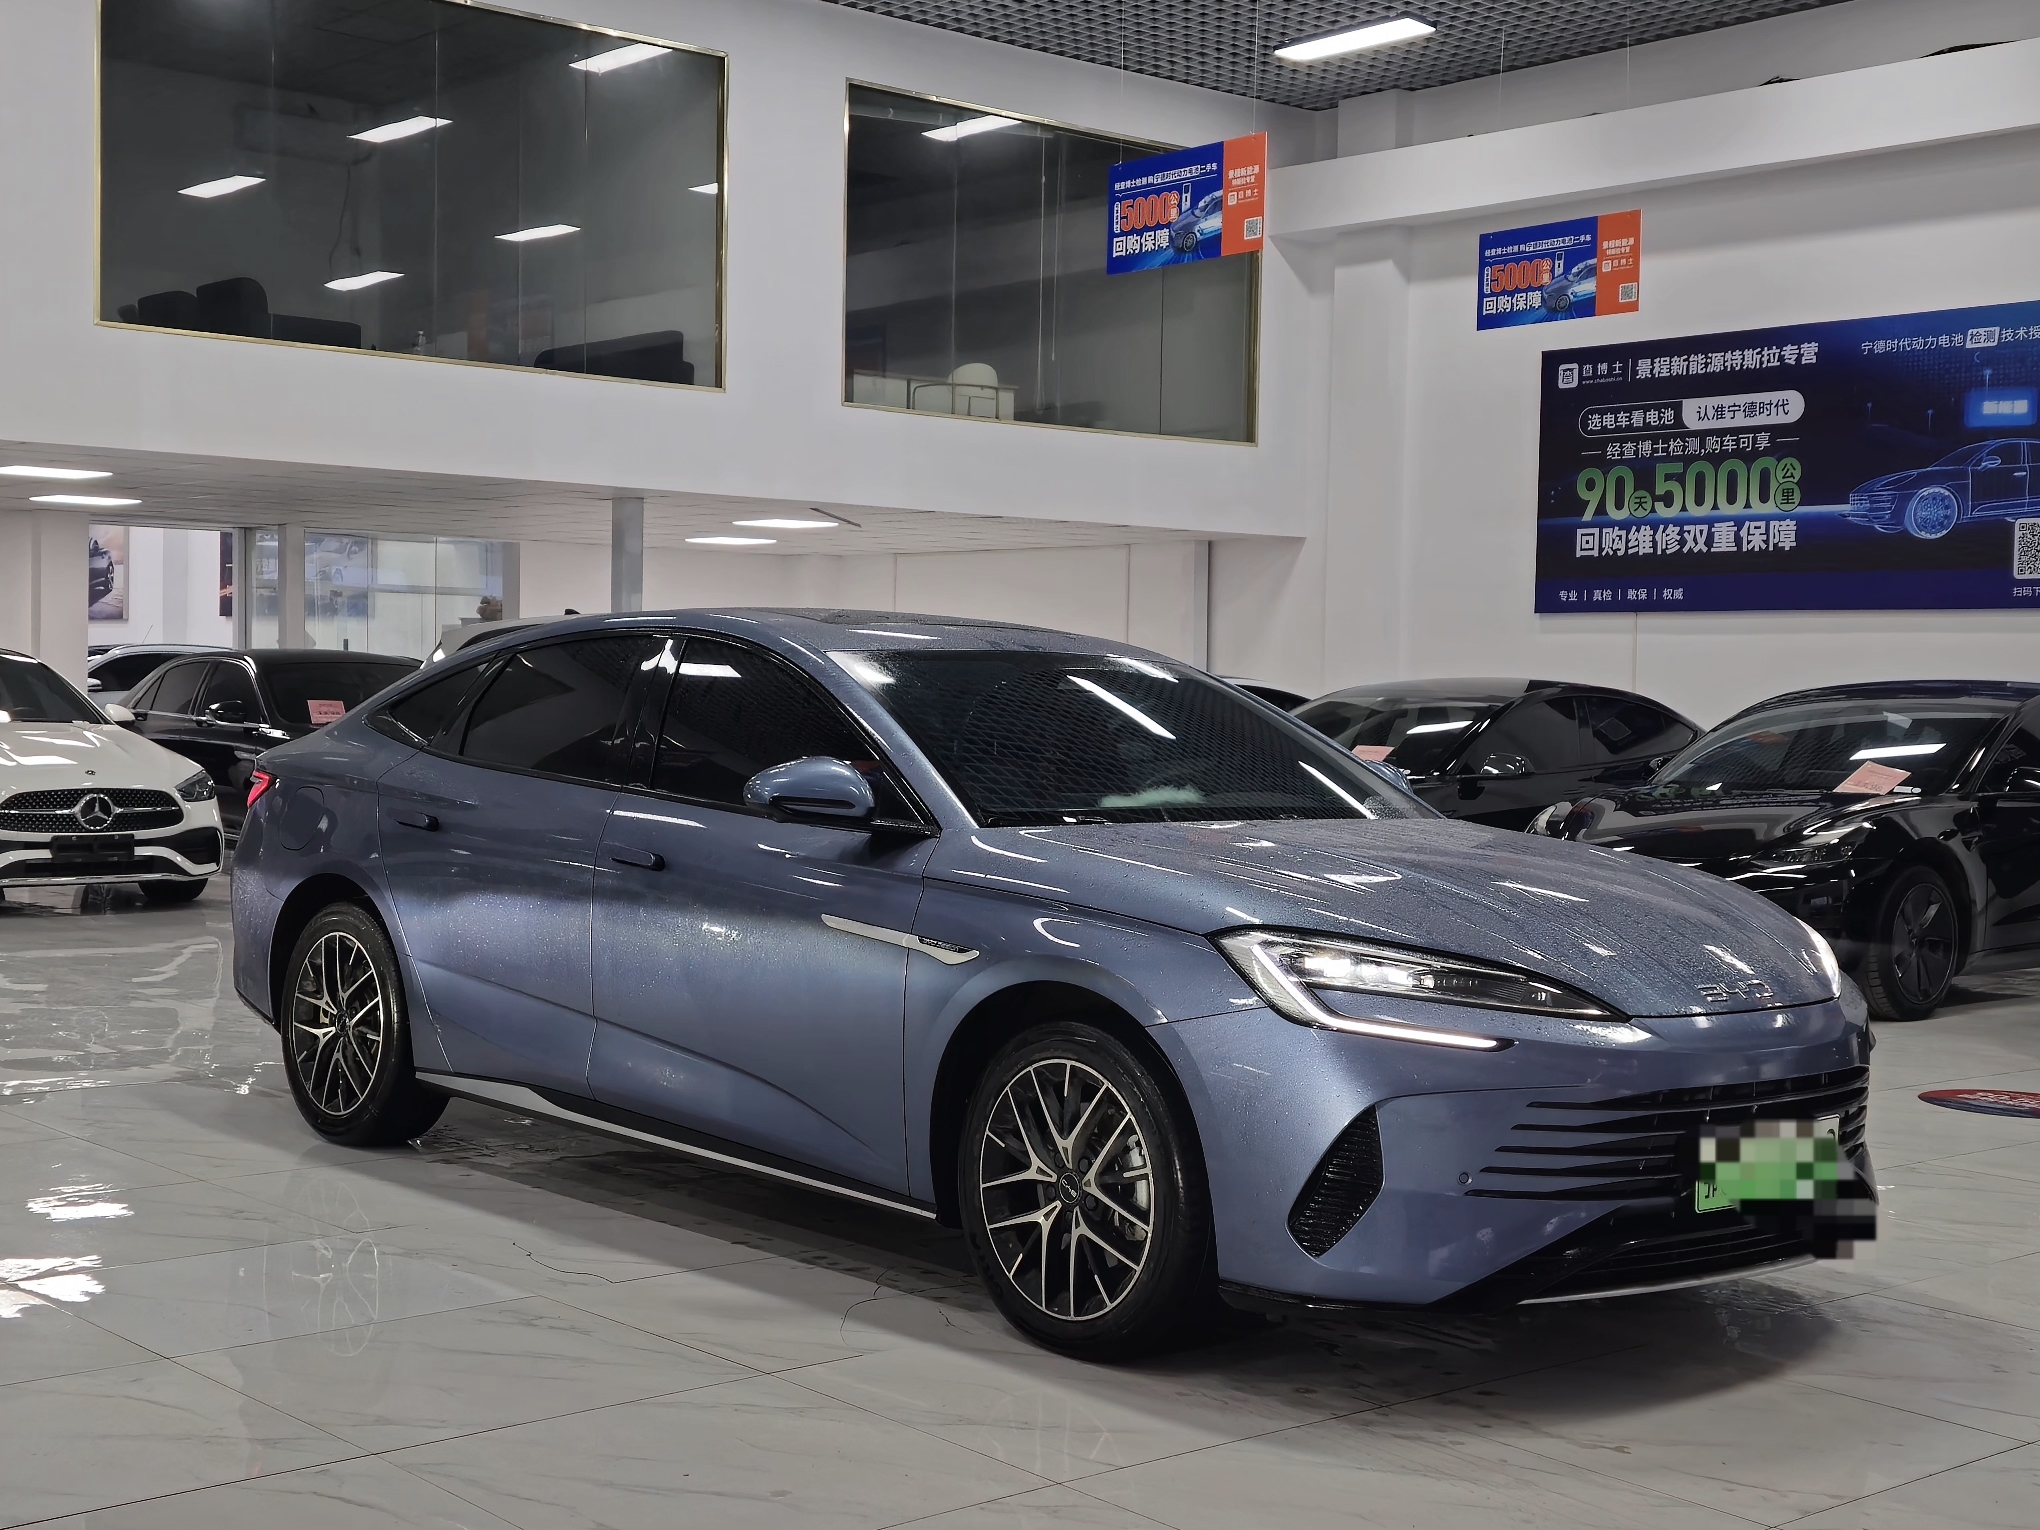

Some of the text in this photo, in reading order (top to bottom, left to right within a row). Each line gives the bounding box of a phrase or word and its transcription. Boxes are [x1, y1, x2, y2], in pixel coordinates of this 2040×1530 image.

[1120, 191, 1172, 232] 5000
[1112, 228, 1170, 258] 回购保障
[1490, 259, 1544, 293] 5000
[1483, 291, 1542, 316] 回购保障
[1636, 342, 1819, 379] 景程新能源特斯拉专营
[1587, 398, 1790, 431] 选电车看电池 认准宁德时代
[1576, 465, 1634, 522] 90
[1654, 456, 1778, 518] 5000
[1575, 519, 1798, 558] 回购维修双重保障
[1559, 587, 1684, 601] 专业 真检 敢保 权威
[1694, 979, 1774, 1002] BYD
